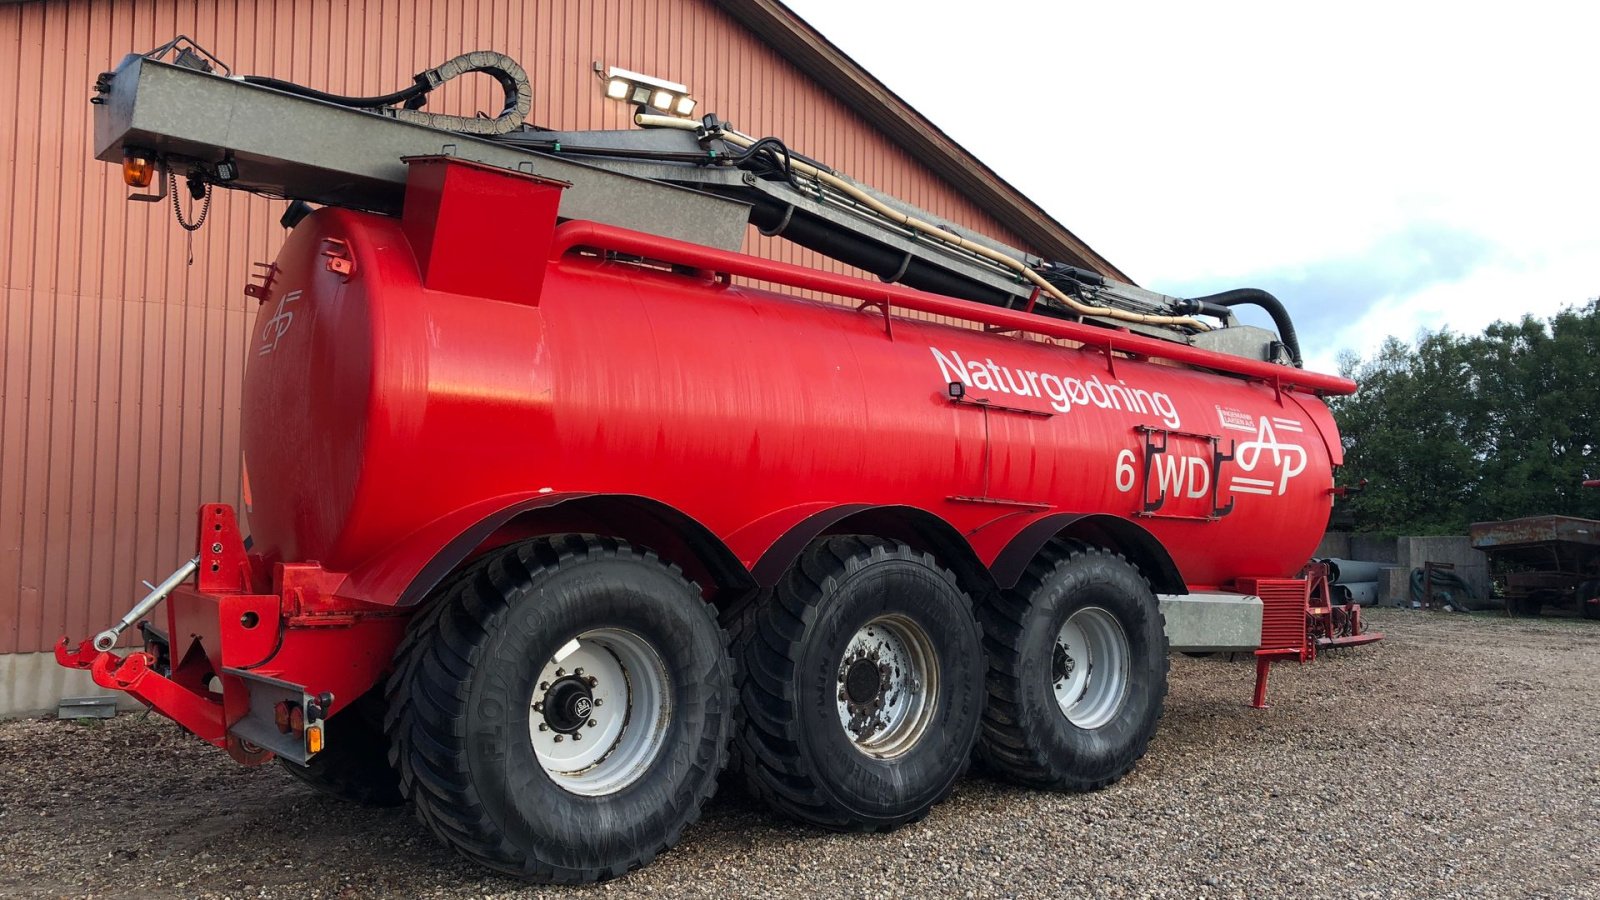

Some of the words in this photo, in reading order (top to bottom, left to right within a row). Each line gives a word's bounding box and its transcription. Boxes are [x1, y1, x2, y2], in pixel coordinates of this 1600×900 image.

[929, 346, 1181, 429] Naturgødning
[1115, 449, 1136, 492] 6
[1153, 453, 1210, 499] WD
[1236, 415, 1307, 496] AP
